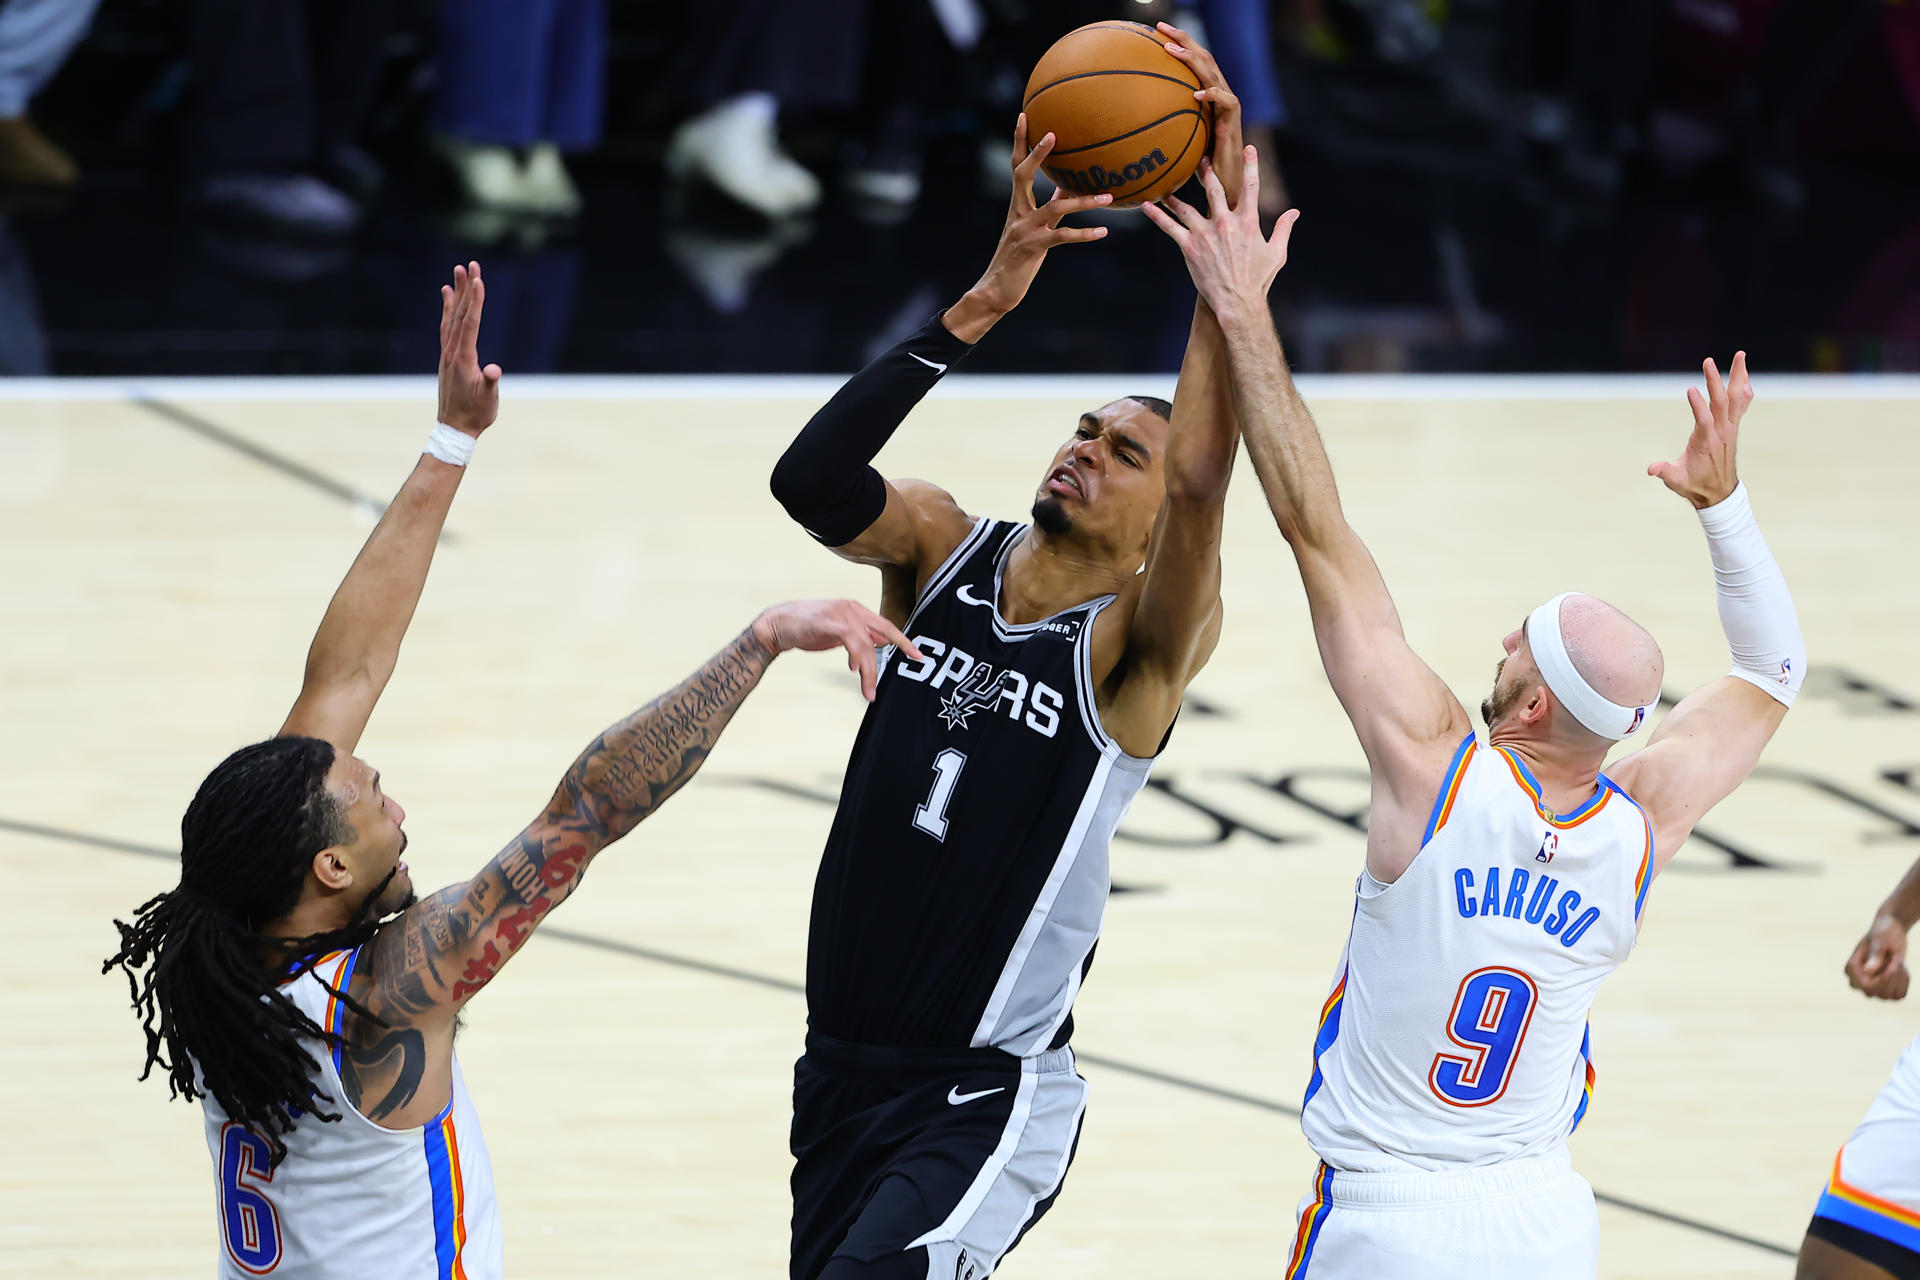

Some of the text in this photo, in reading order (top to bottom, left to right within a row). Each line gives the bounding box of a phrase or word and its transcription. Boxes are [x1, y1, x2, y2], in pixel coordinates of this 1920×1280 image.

[1045, 148, 1169, 194] Wilson
[897, 635, 1064, 738] SPURS
[911, 747, 968, 843] 1
[1454, 867, 1600, 948] CARUSO
[1428, 966, 1538, 1108] 9
[219, 1120, 283, 1275] 6
